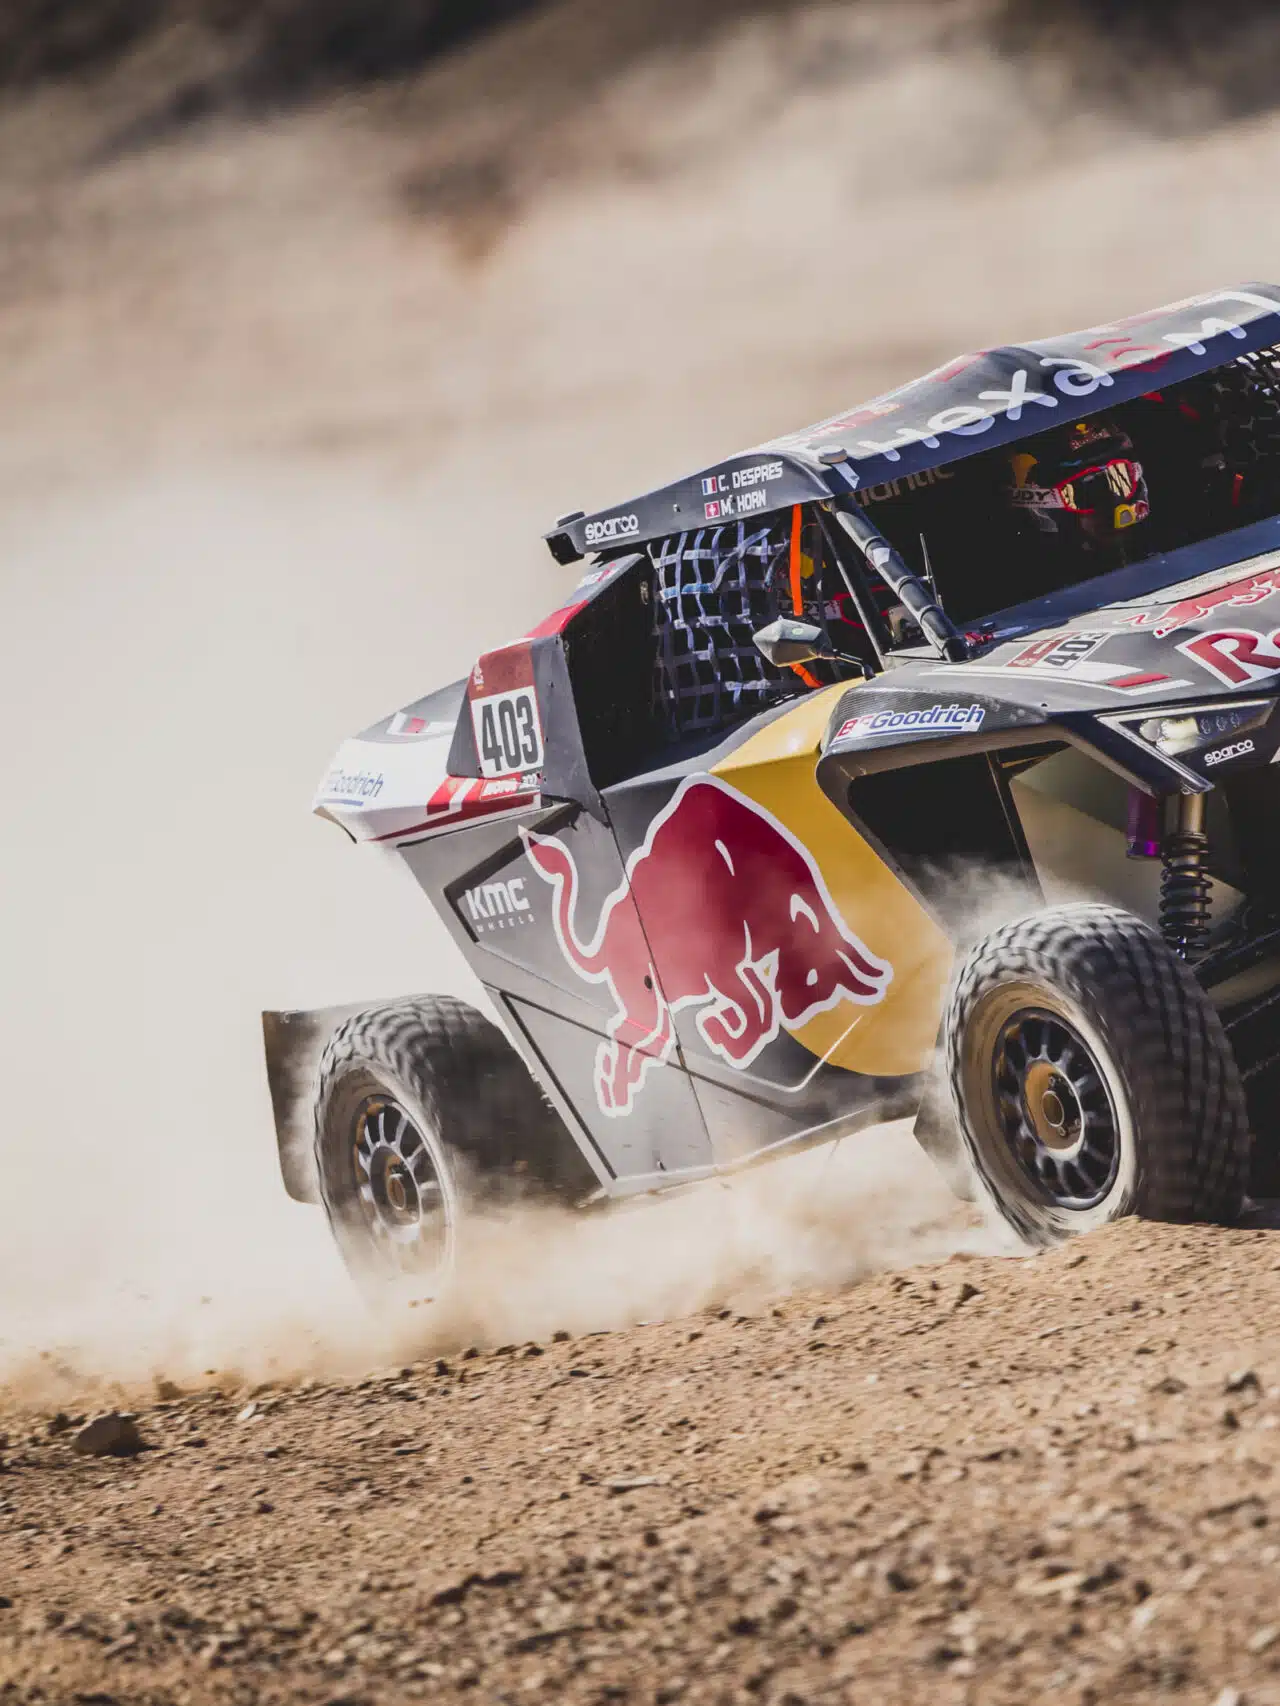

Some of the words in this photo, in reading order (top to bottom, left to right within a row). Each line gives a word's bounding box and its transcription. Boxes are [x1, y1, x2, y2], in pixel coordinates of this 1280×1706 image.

[718, 473, 730, 492] C.
[732, 461, 783, 488] DESPRES
[737, 489, 767, 513] HORN
[585, 514, 639, 542] sparco
[482, 695, 538, 771] 403
[1204, 739, 1254, 764] sparco
[464, 878, 530, 920] KMC
